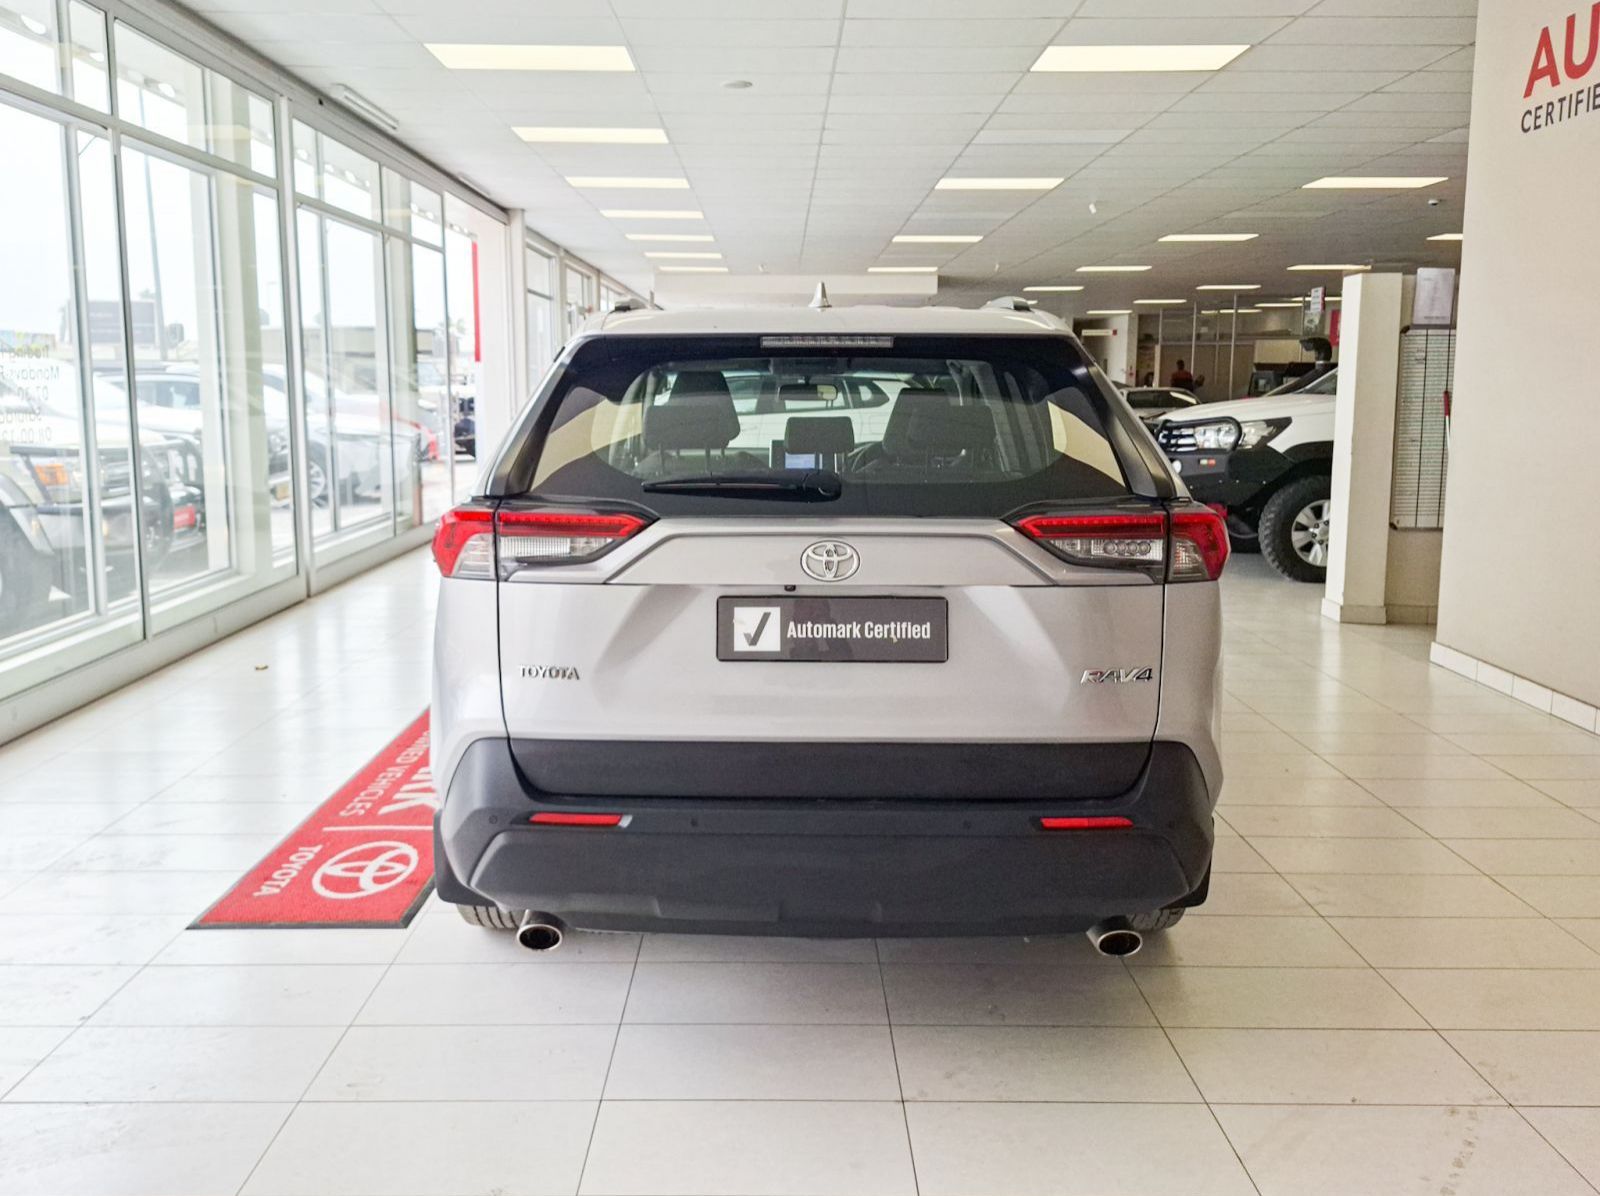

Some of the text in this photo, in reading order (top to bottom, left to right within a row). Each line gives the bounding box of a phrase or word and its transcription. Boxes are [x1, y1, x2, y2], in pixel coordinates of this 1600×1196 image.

[1523, 1, 1600, 99] AU
[1520, 82, 1600, 134] CERTIFIE
[786, 621, 931, 639] Automark Certified
[519, 664, 580, 681] TOYOTA
[1080, 665, 1153, 684] RAV4
[339, 764, 411, 817] VEHICLES
[253, 844, 323, 897] TOYOTA
